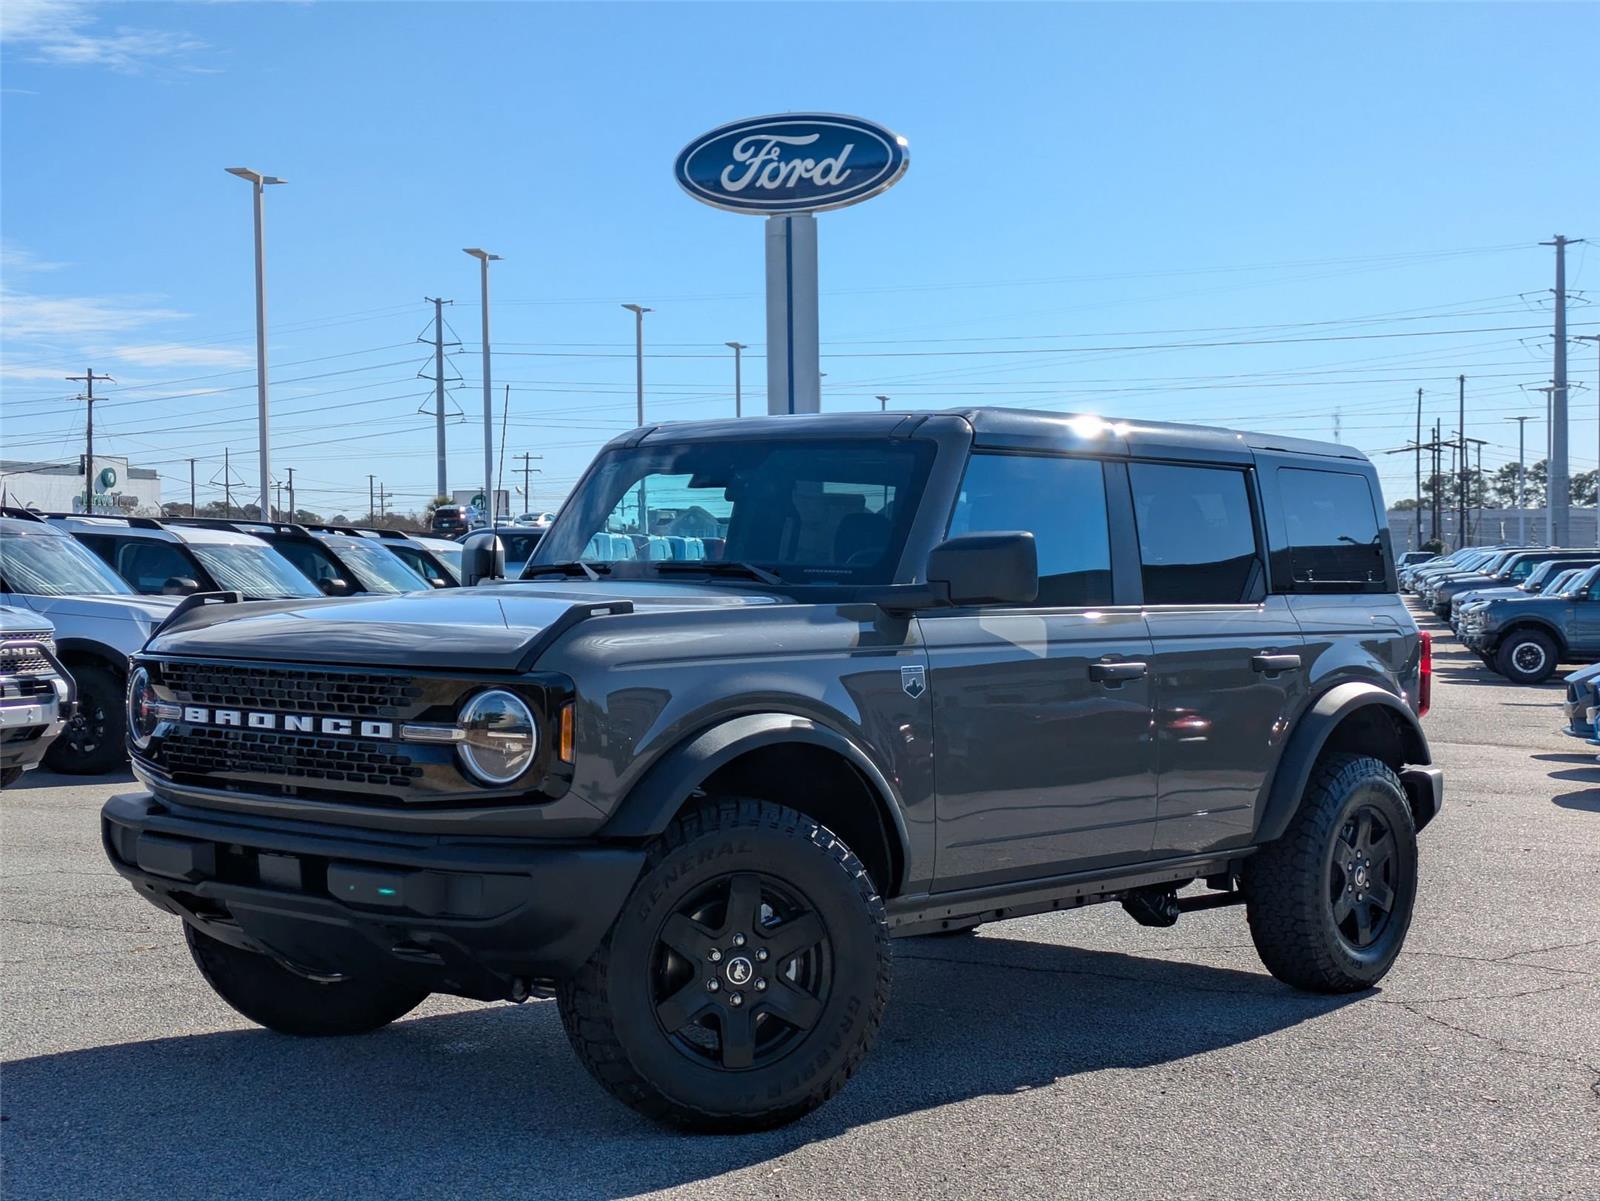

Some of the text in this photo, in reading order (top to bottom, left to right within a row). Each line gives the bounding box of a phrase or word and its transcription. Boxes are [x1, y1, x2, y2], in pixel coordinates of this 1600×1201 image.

[721, 133, 855, 192] Ford
[0, 648, 41, 656] ONC
[184, 706, 393, 738] BRONCO
[639, 840, 753, 922] GENERAL
